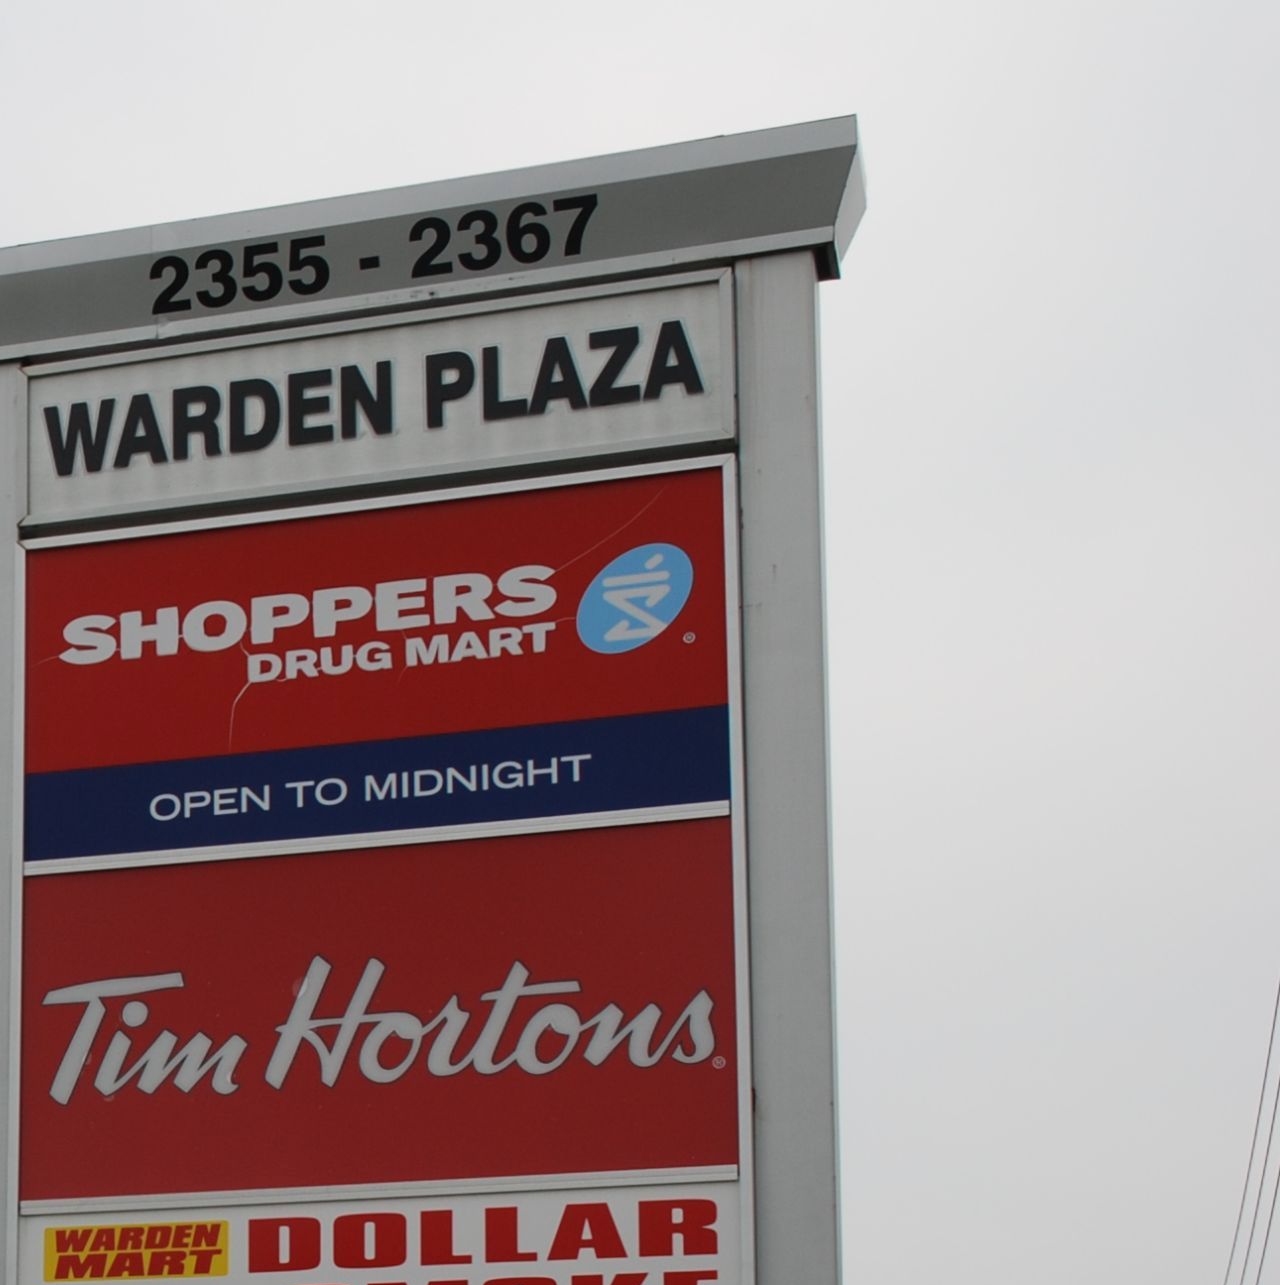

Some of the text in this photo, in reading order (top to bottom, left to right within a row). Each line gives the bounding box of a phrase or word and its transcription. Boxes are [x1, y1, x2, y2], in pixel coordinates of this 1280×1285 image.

[148, 235, 331, 315] 2355
[409, 194, 600, 278] 2367
[43, 319, 705, 478] WARDEN PLAZA
[59, 564, 558, 665] SHOPPERS
[247, 621, 557, 682] DRUG MART
[149, 754, 592, 821] OPEN TO MIDNIGHT
[42, 954, 716, 1106] Tim Hortons
[54, 1248, 223, 1280] MART
[55, 1223, 222, 1254] WARDEN
[248, 1198, 720, 1274] DOLLAR
